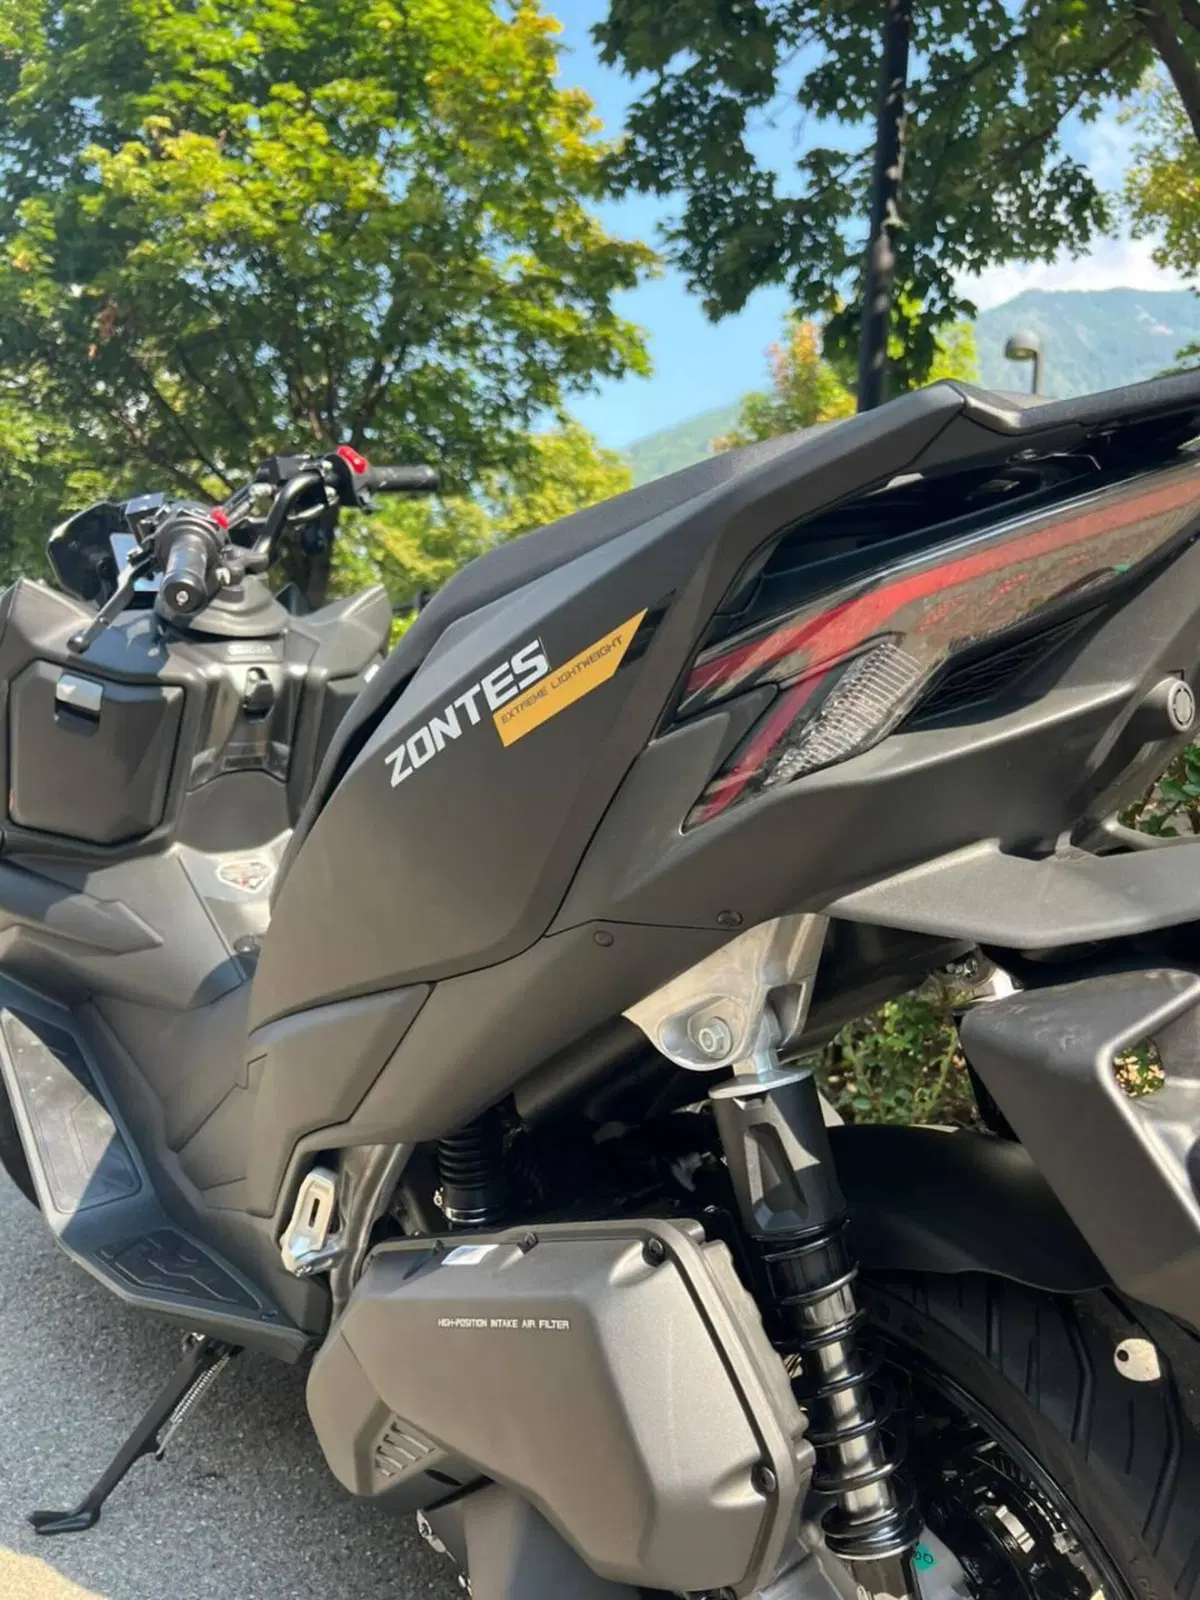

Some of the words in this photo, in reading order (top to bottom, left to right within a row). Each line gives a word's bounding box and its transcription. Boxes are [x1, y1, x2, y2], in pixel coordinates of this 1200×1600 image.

[385, 640, 549, 787] ZONTES
[501, 687, 549, 725] EXTREME
[551, 635, 624, 689] LIGHTWEIGHT
[437, 1317, 488, 1329] HIGH-POSITION
[490, 1318, 518, 1329] INTAKE
[521, 1319, 536, 1329] AIR
[538, 1319, 570, 1330] FILTER
